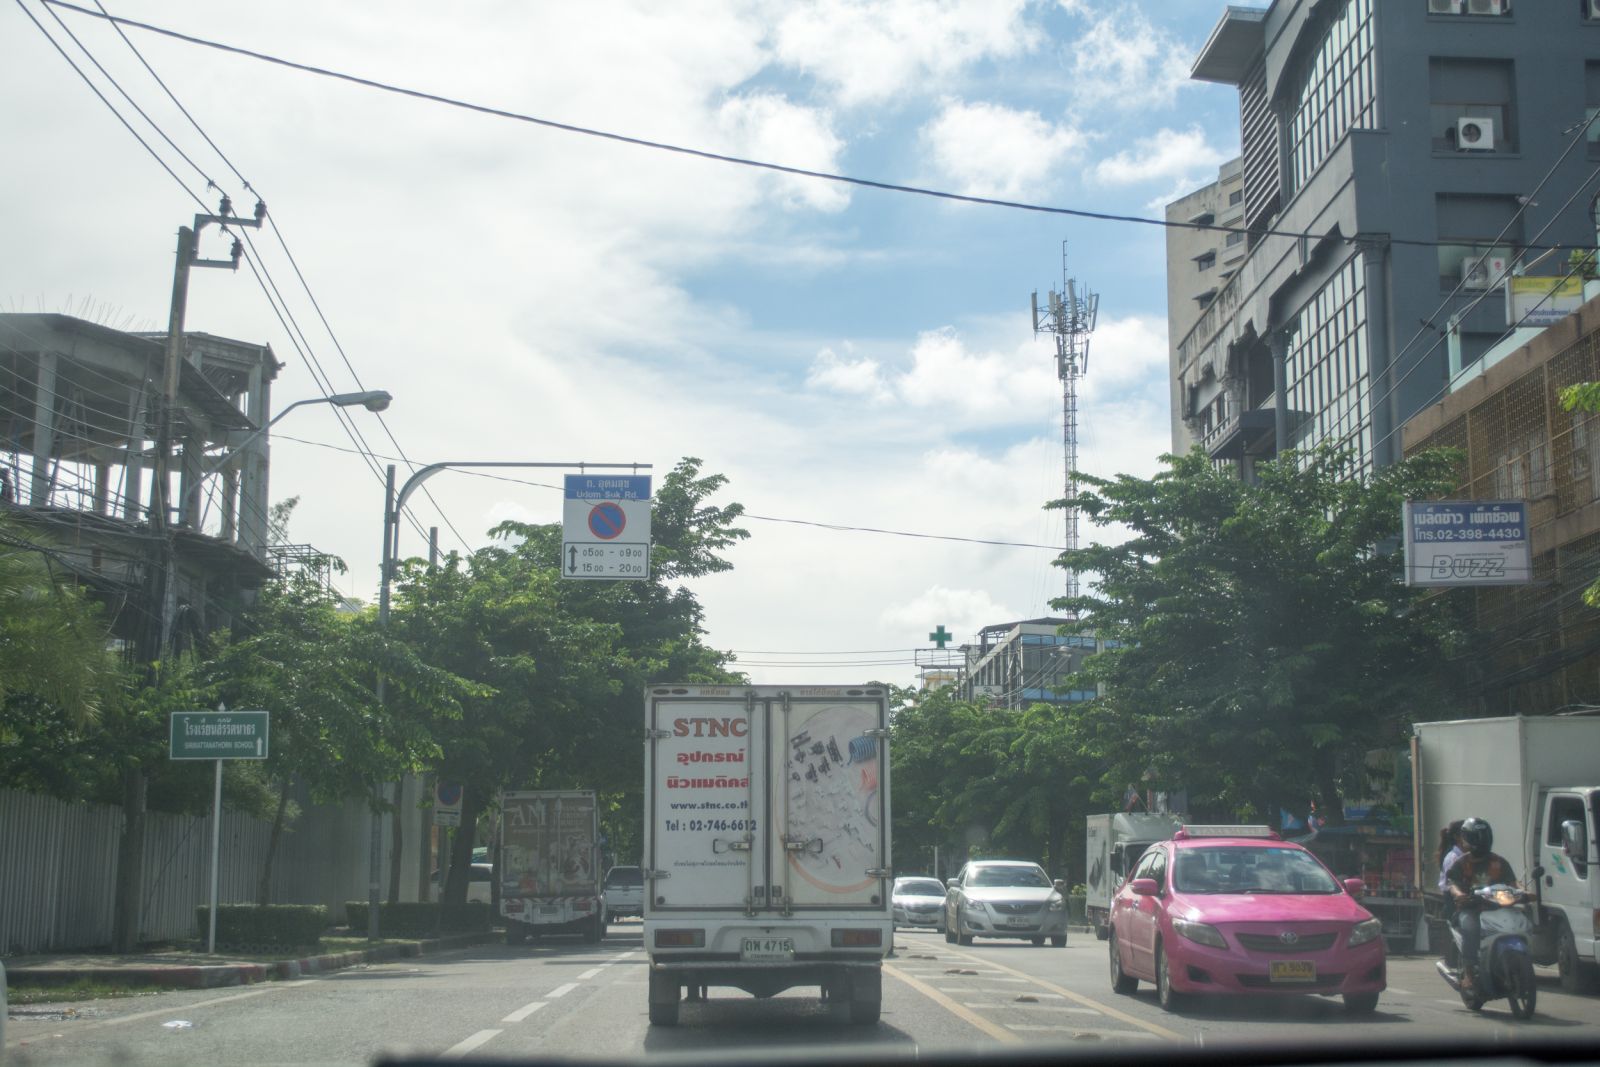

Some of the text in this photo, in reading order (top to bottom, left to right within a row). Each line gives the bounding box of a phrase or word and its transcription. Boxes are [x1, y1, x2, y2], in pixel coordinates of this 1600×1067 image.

[577, 491, 639, 499] Udom Suk Rd.
[1414, 527, 1521, 540] โทร.02-398-4430
[673, 717, 748, 738] STNC
[677, 748, 745, 765] อุปกรณ์
[665, 820, 680, 831] Tel
[689, 819, 757, 832] 02-746-6612
[764, 940, 791, 952] 4715
